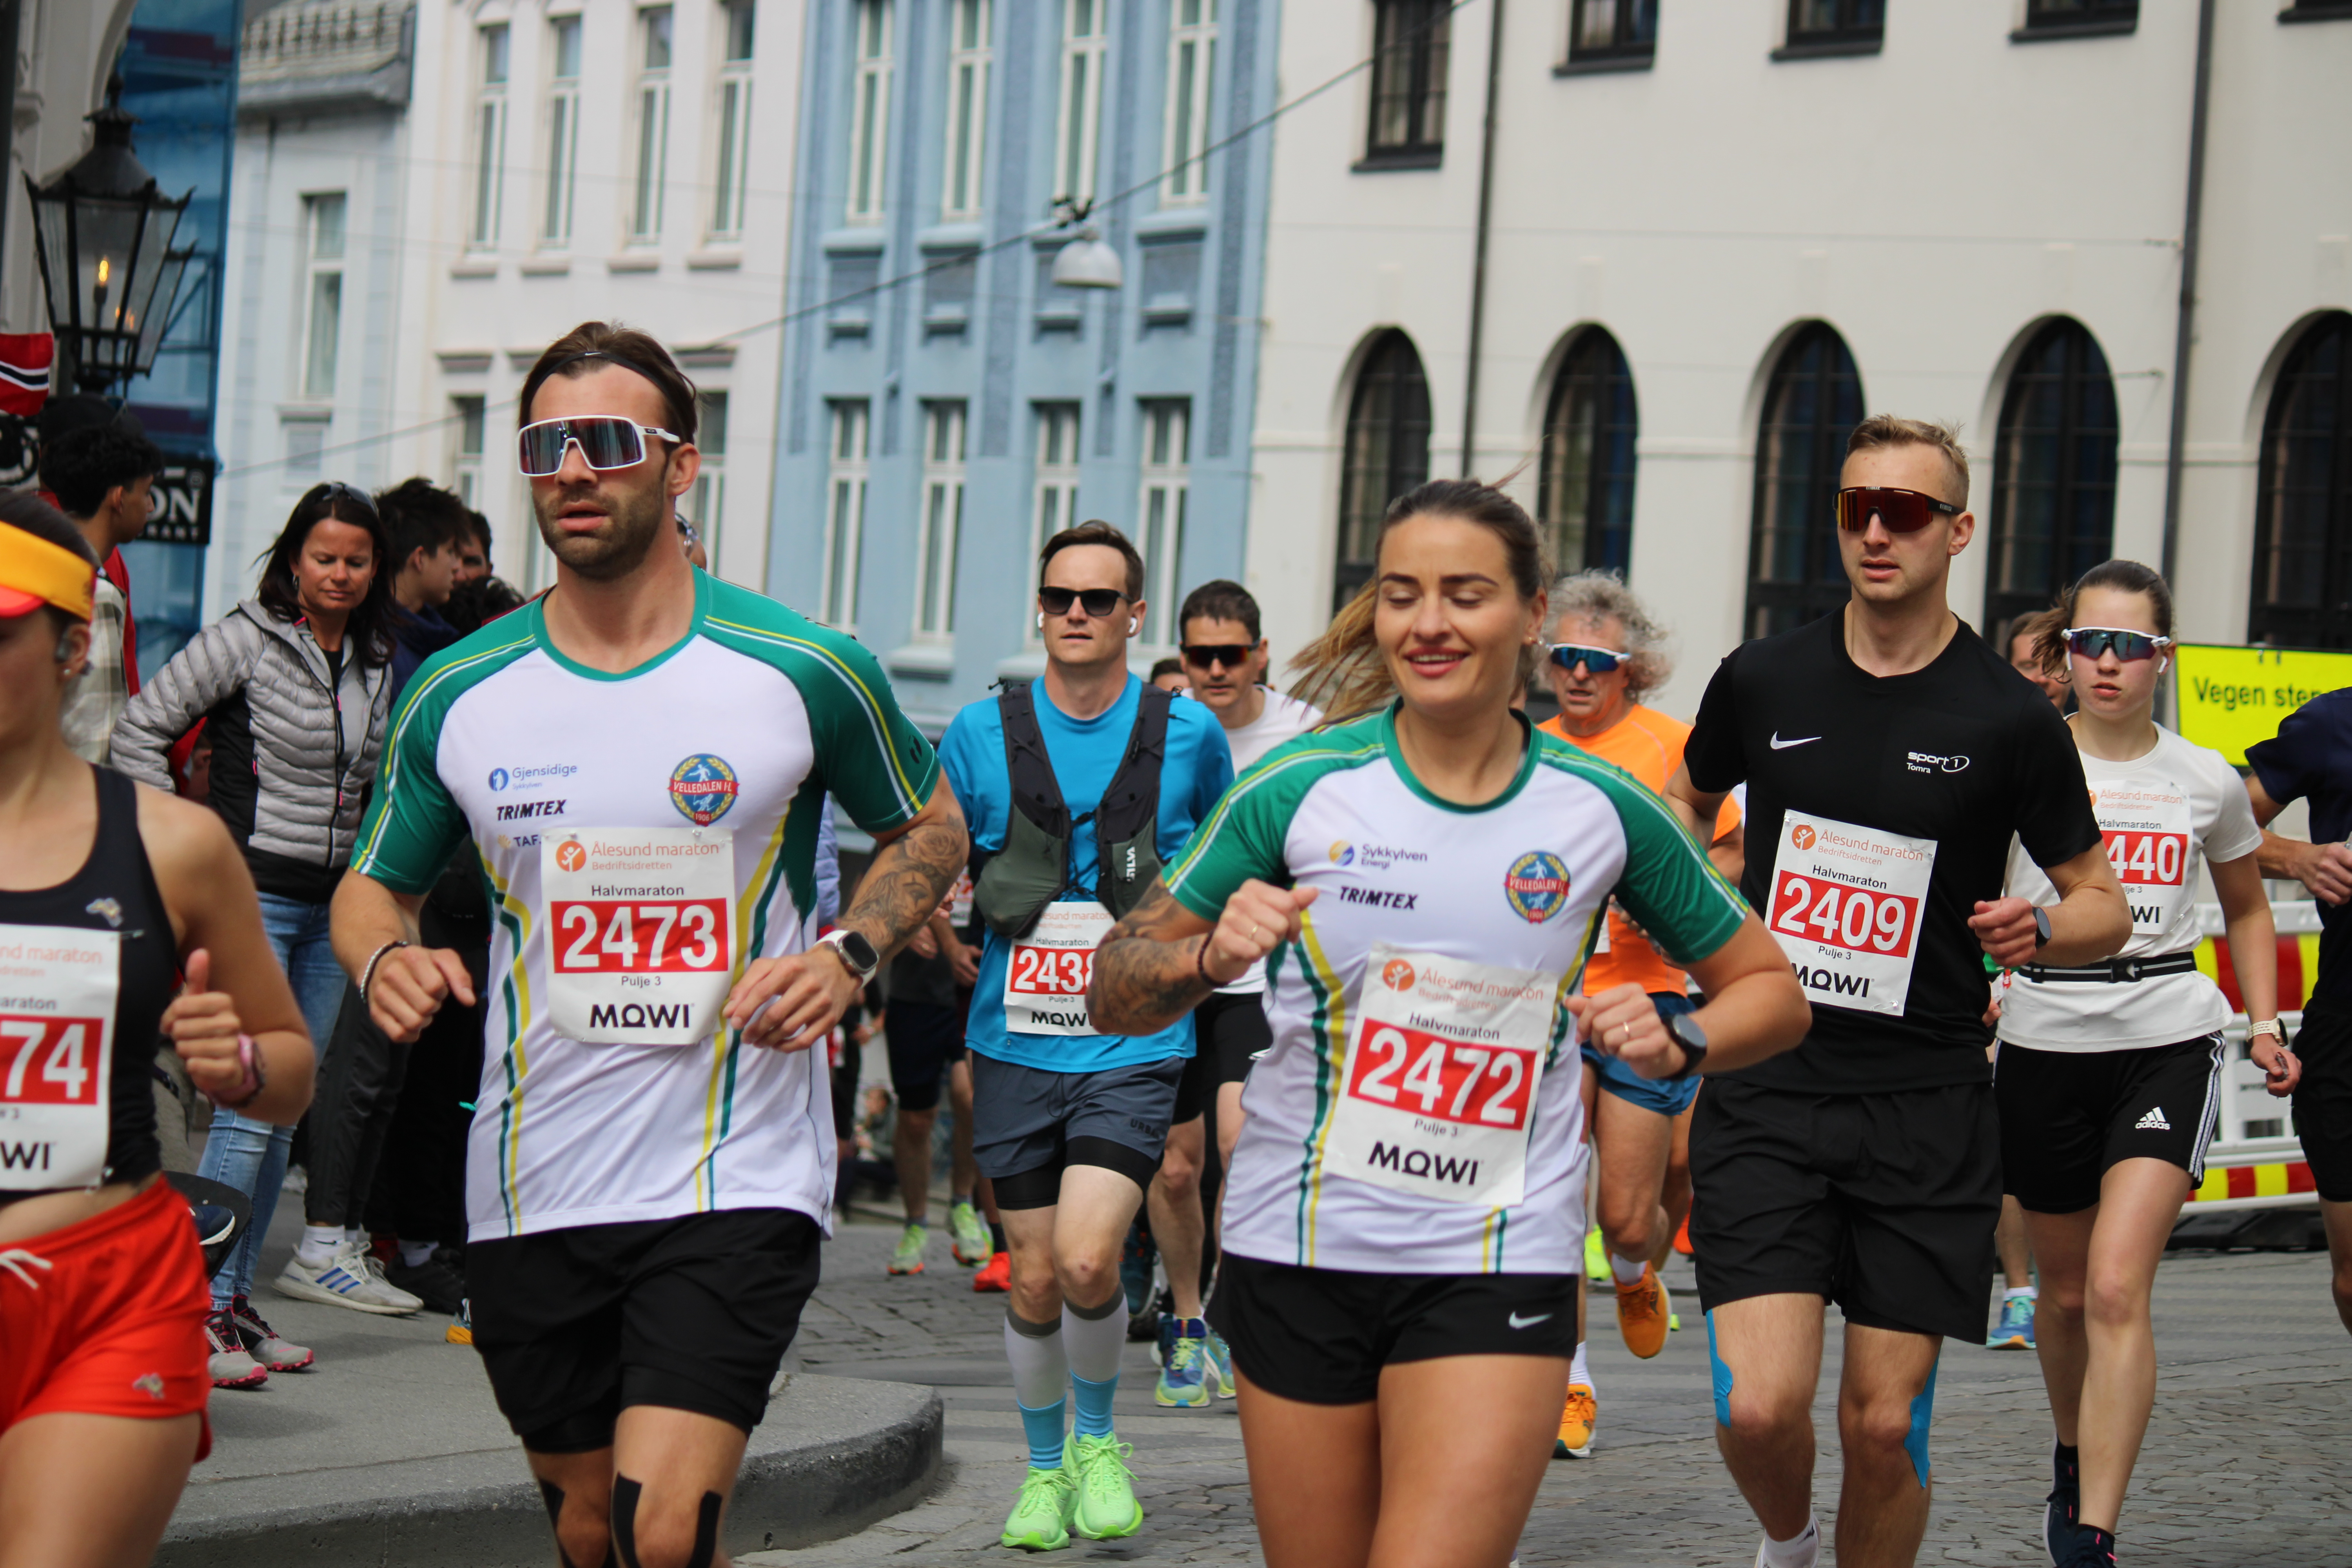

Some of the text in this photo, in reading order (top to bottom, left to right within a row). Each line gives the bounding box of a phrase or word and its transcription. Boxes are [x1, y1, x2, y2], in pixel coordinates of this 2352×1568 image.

[2194, 677, 2265, 711] Vegen
[1908, 752, 1949, 766] sport
[512, 764, 577, 780] Gjensidige
[1907, 762, 1931, 773] Tomra
[512, 782, 543, 790] Sykkylven
[674, 781, 721, 793] VELLEDALEN
[2143, 793, 2182, 804] maraton
[497, 799, 567, 820] TRIMTEX
[2099, 818, 2161, 829] Halvmaraton
[513, 835, 541, 847] TAF
[592, 841, 719, 857] Ålesund maraton
[1820, 829, 1923, 862] Ålesund maraton
[1362, 843, 1428, 862] Sykkylven
[1818, 846, 1882, 866] Bedriftsidretten
[2107, 835, 2180, 882] 440
[592, 861, 672, 870] Bedriftsidretten
[1361, 857, 1390, 869] Energi
[1510, 877, 1557, 891] VELLEDALEN
[1812, 864, 1887, 890] Halvmaraton
[592, 885, 684, 897] Halvmaraton
[1340, 886, 1419, 910] TRIMTEX
[1777, 877, 1906, 951] 2409
[562, 904, 718, 968] 2473
[1036, 937, 1089, 946] Halvmaraton
[27, 947, 103, 964] maraton
[1818, 946, 1842, 959] Pulje
[621, 976, 661, 988] Pulje 3
[1421, 967, 1544, 1001] Ålesund maraton
[1418, 987, 1497, 1011] Bedriftsidretten
[1032, 1011, 1092, 1027] MOW
[1409, 1011, 1500, 1040] Halvmaraton
[1, 1022, 88, 1099] 74
[1358, 1027, 1523, 1125] 2472
[1414, 1118, 1458, 1137] Pulje 3
[2135, 1120, 2171, 1130] adidas
